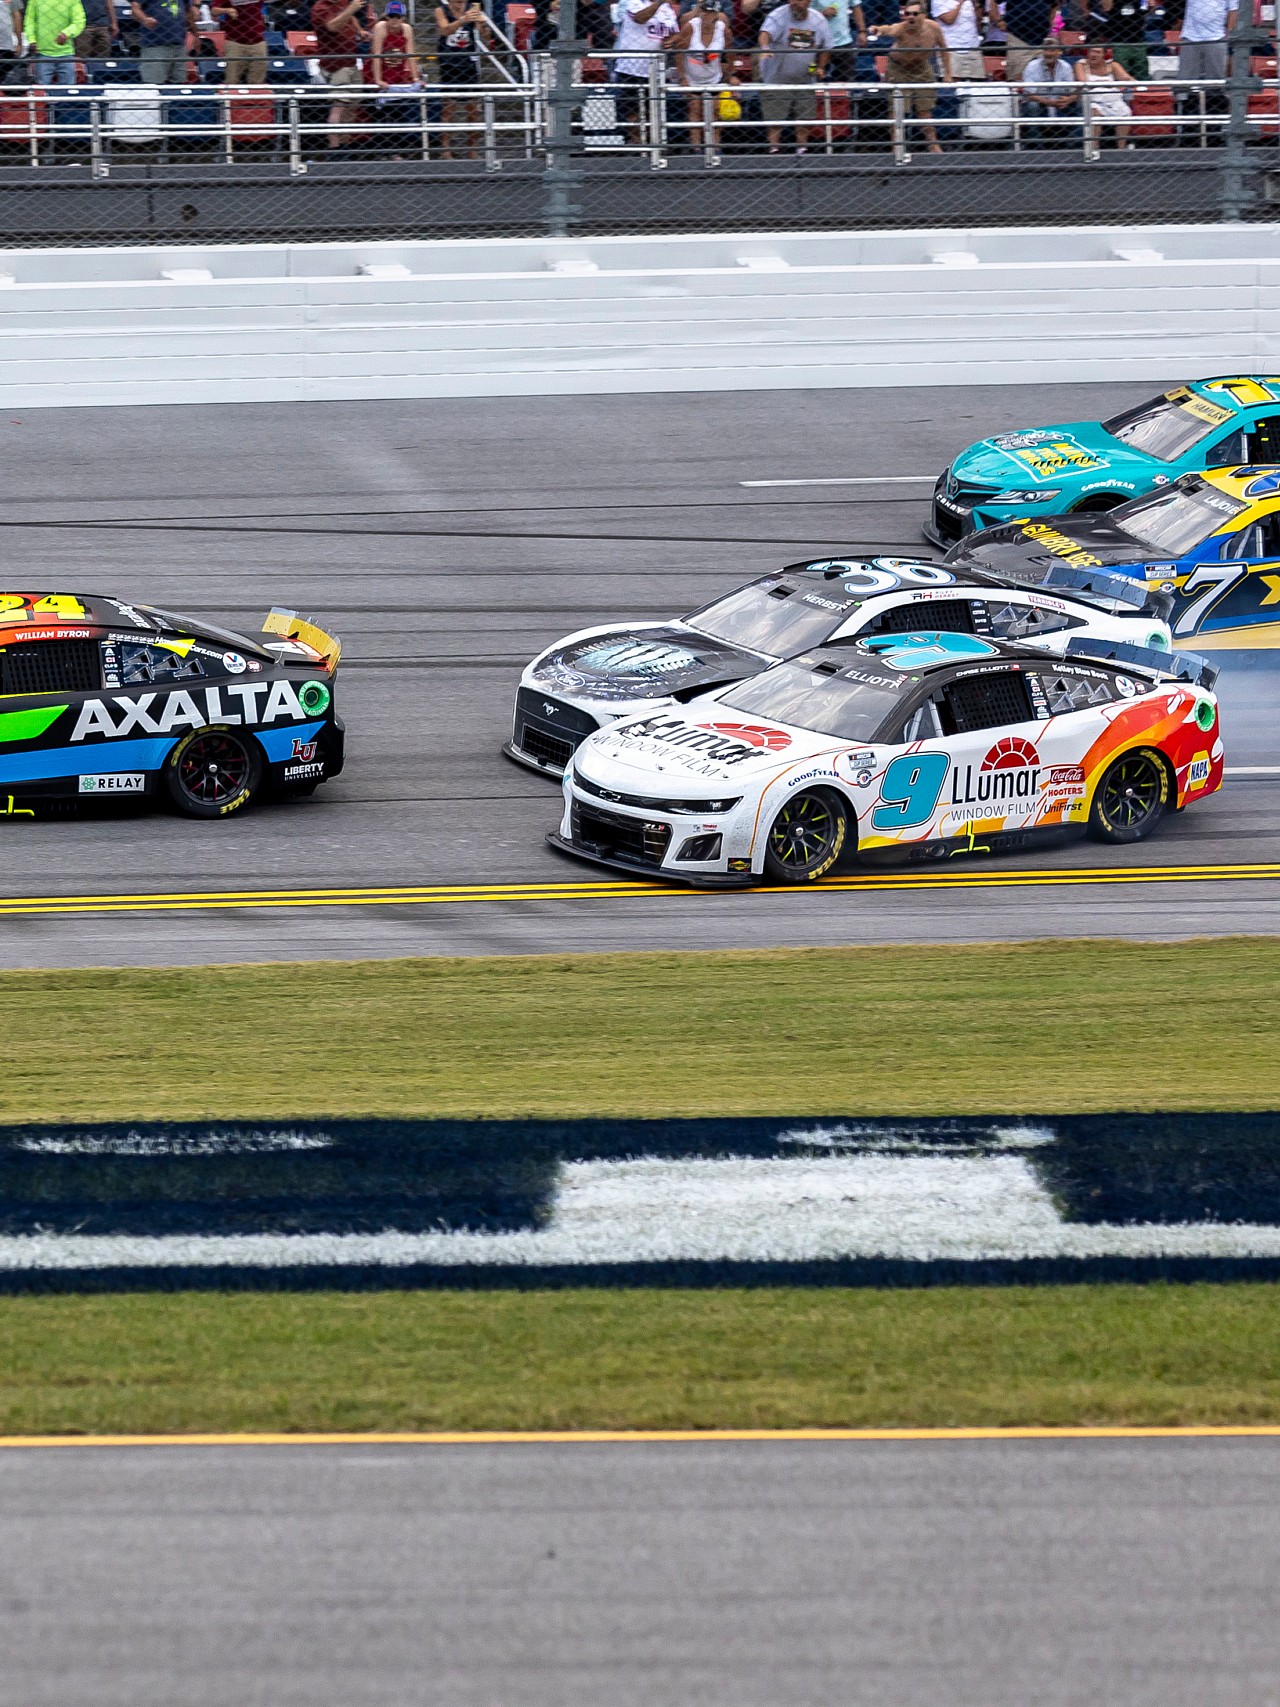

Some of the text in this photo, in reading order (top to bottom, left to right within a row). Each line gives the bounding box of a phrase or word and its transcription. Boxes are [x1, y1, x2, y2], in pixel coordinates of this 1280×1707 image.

[936, 494, 966, 514] CAMRY
[1204, 496, 1238, 514] LAJOIE
[807, 557, 957, 595] 36
[802, 594, 847, 611] HERBST
[1170, 562, 1249, 641] 7
[15, 630, 90, 640] WILLIAM BYRON
[956, 665, 1010, 677] CHASE ELLIOTT
[1052, 664, 1074, 674] Kelley
[845, 670, 900, 689] ELLIOTT
[70, 680, 306, 741] AXALTA
[291, 738, 317, 762] LU
[592, 735, 721, 777] WINDOW FILM
[284, 762, 324, 776] LIBERTY
[284, 771, 324, 781] UNIVERSITY
[788, 768, 840, 788] GOODYEAR
[1190, 759, 1208, 780] NAPA
[98, 778, 142, 789] RELAY
[871, 751, 951, 831] 9
[952, 765, 1041, 804] LLumar
[1048, 787, 1083, 797] HOOTERS
[951, 802, 1036, 821] WINDOW FILM
[1044, 802, 1083, 814] UniFirst
